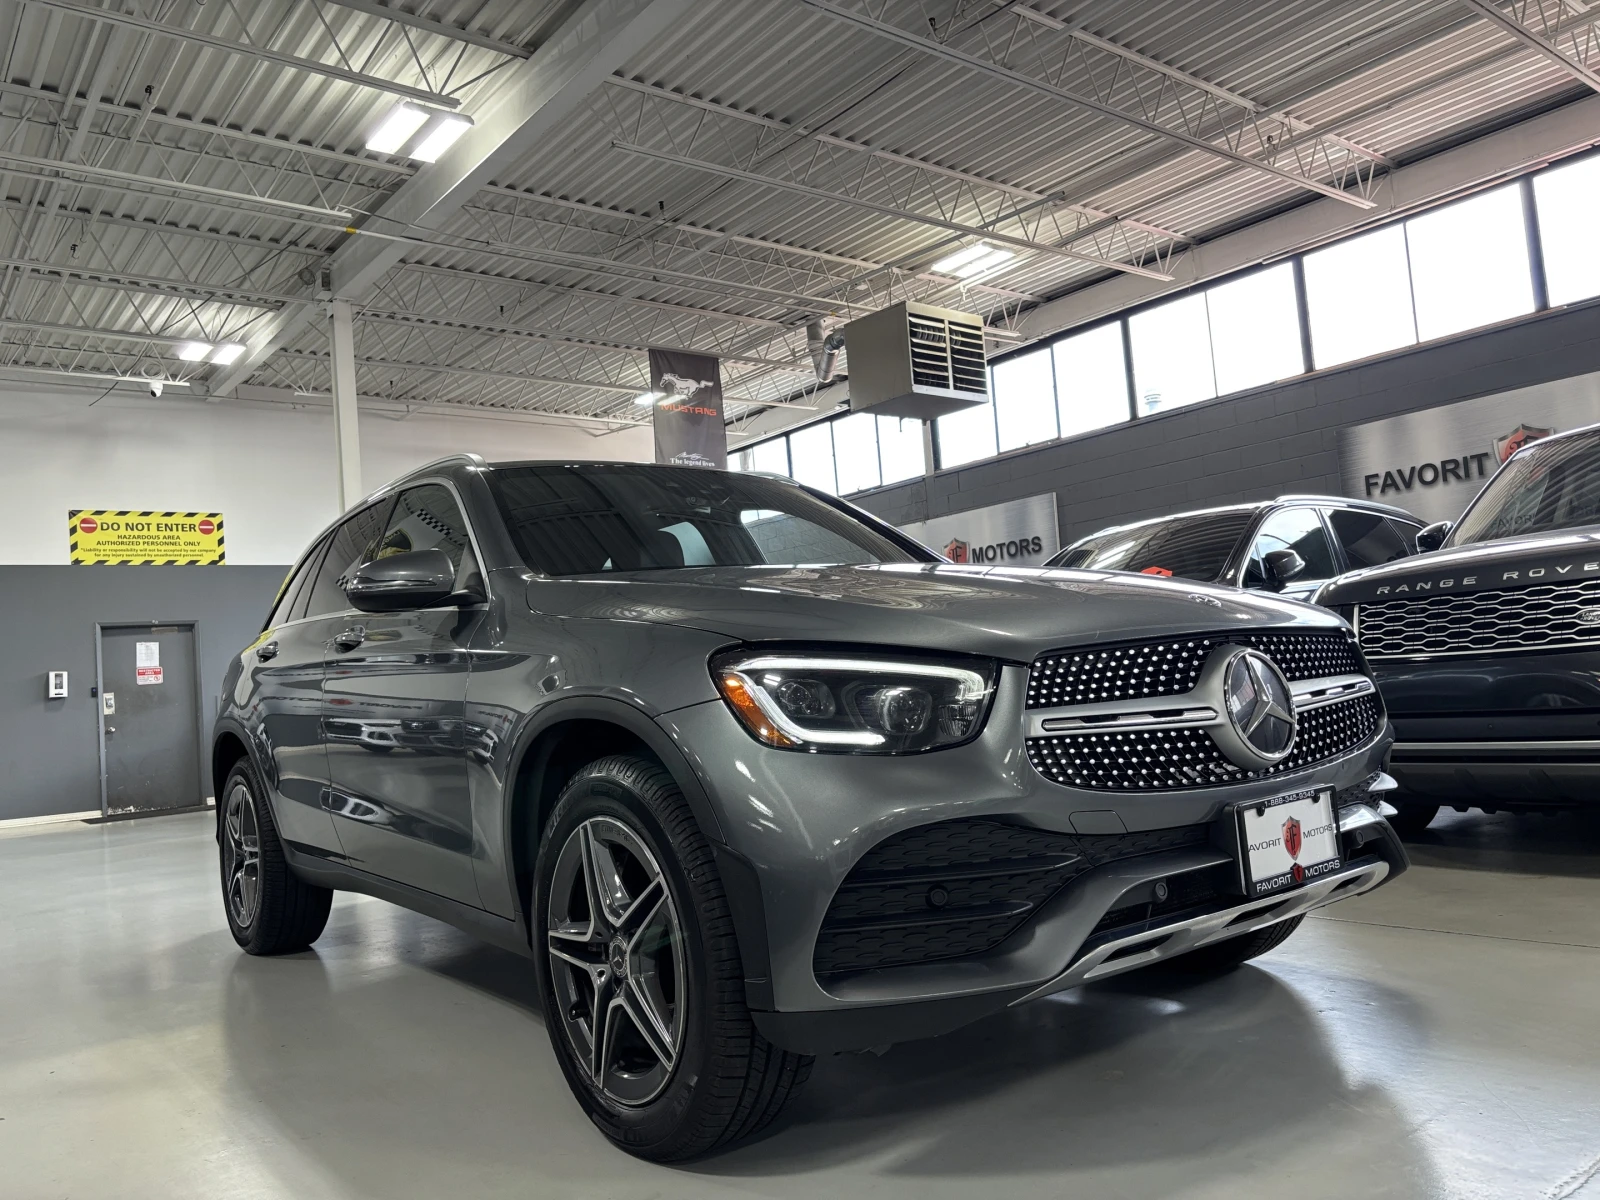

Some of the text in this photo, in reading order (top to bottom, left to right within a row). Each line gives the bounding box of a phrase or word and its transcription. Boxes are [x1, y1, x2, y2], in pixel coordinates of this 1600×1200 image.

[661, 404, 717, 416] MUSTANG
[669, 457, 683, 465] The
[683, 459, 702, 467] legend
[1364, 452, 1489, 496] FAVORIT
[101, 522, 197, 533] DO NOT ENTER
[971, 536, 1042, 563] MOTORS
[1376, 561, 1600, 595] RANGE ROVE
[1264, 790, 1315, 808] 1-888-345-9345
[1248, 838, 1281, 853] AVORIT
[1302, 823, 1333, 839] MOTORS
[1256, 859, 1341, 893] FAVORIT MOTORS
